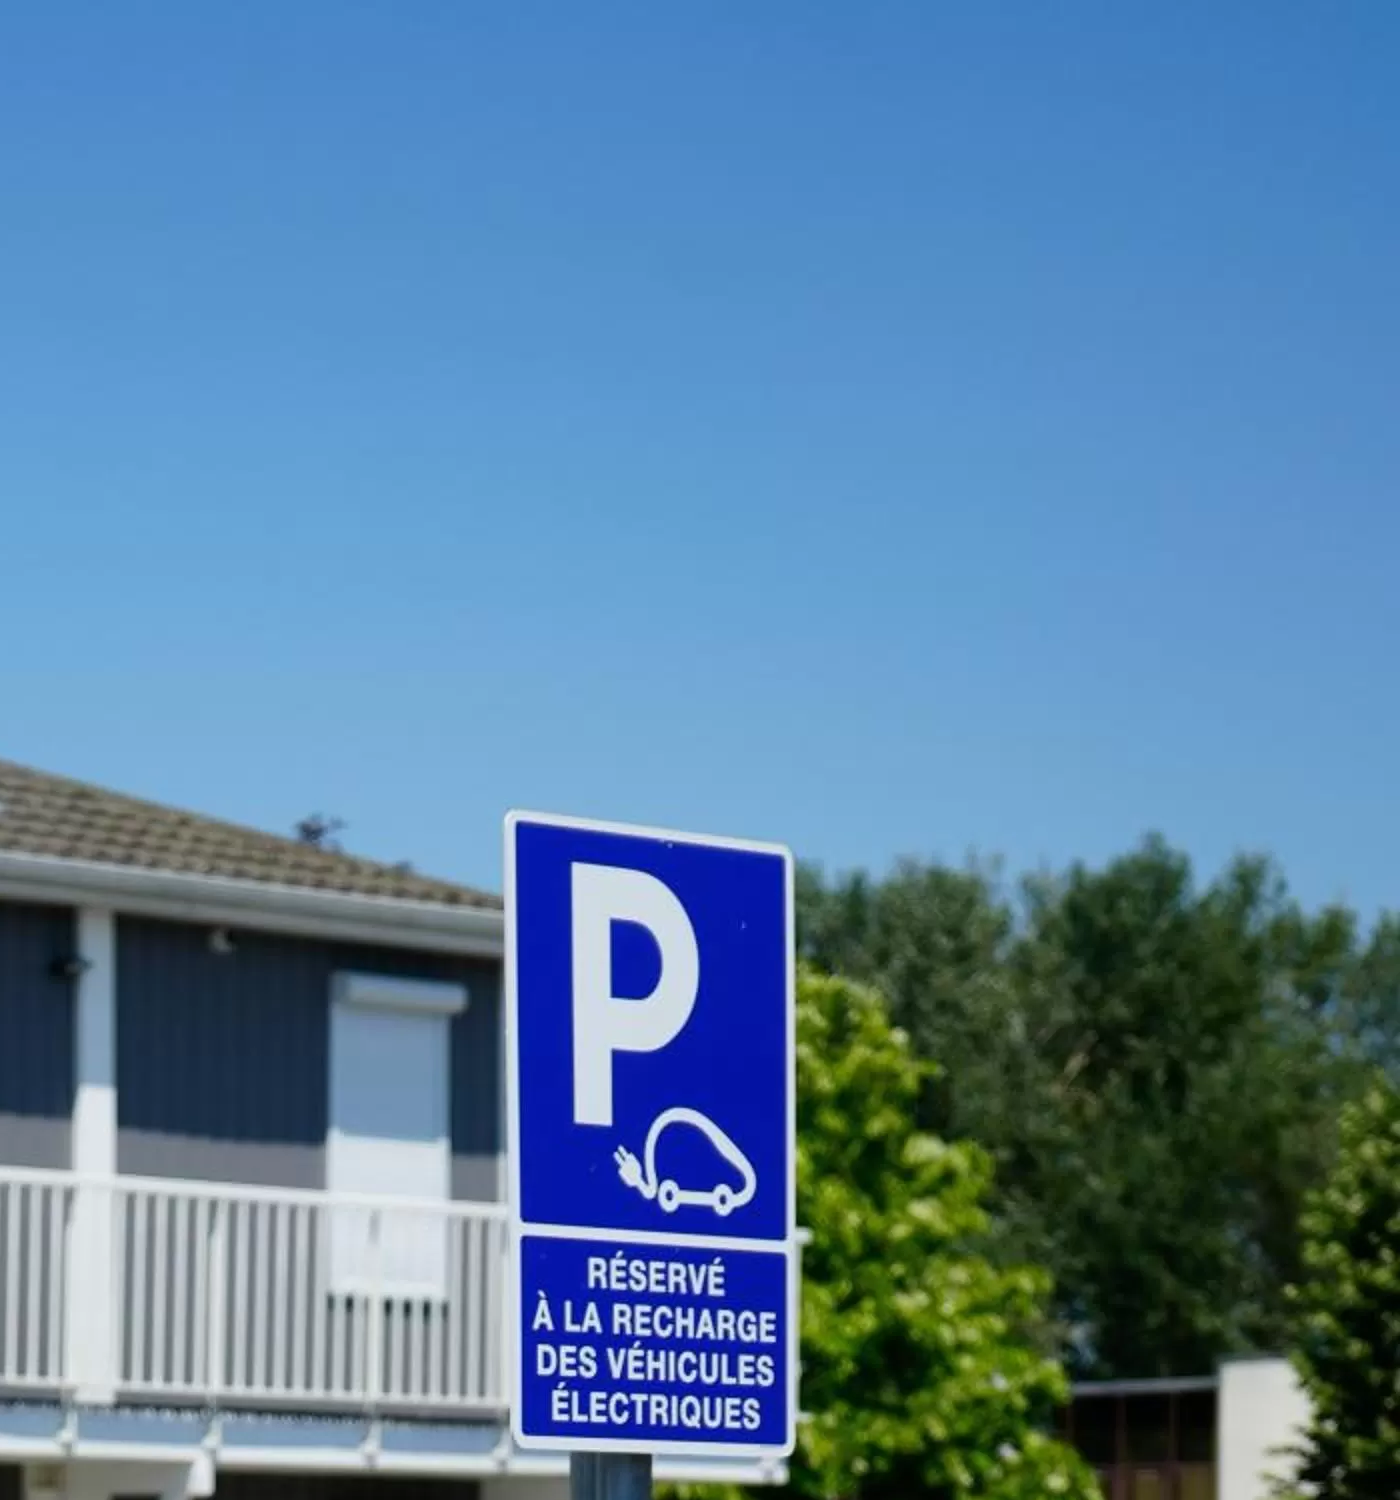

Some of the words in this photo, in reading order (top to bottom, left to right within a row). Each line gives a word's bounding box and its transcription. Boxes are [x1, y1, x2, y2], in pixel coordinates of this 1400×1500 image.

[571, 861, 700, 1127] P
[587, 1250, 725, 1297] RÉSERVÉ
[532, 1290, 555, 1331] À
[564, 1300, 603, 1334] LA
[613, 1305, 777, 1344] RECHARGE
[537, 1343, 597, 1379] DES
[606, 1338, 776, 1387] VÉHICULES
[552, 1383, 761, 1430] ÉLECTRIQUES
